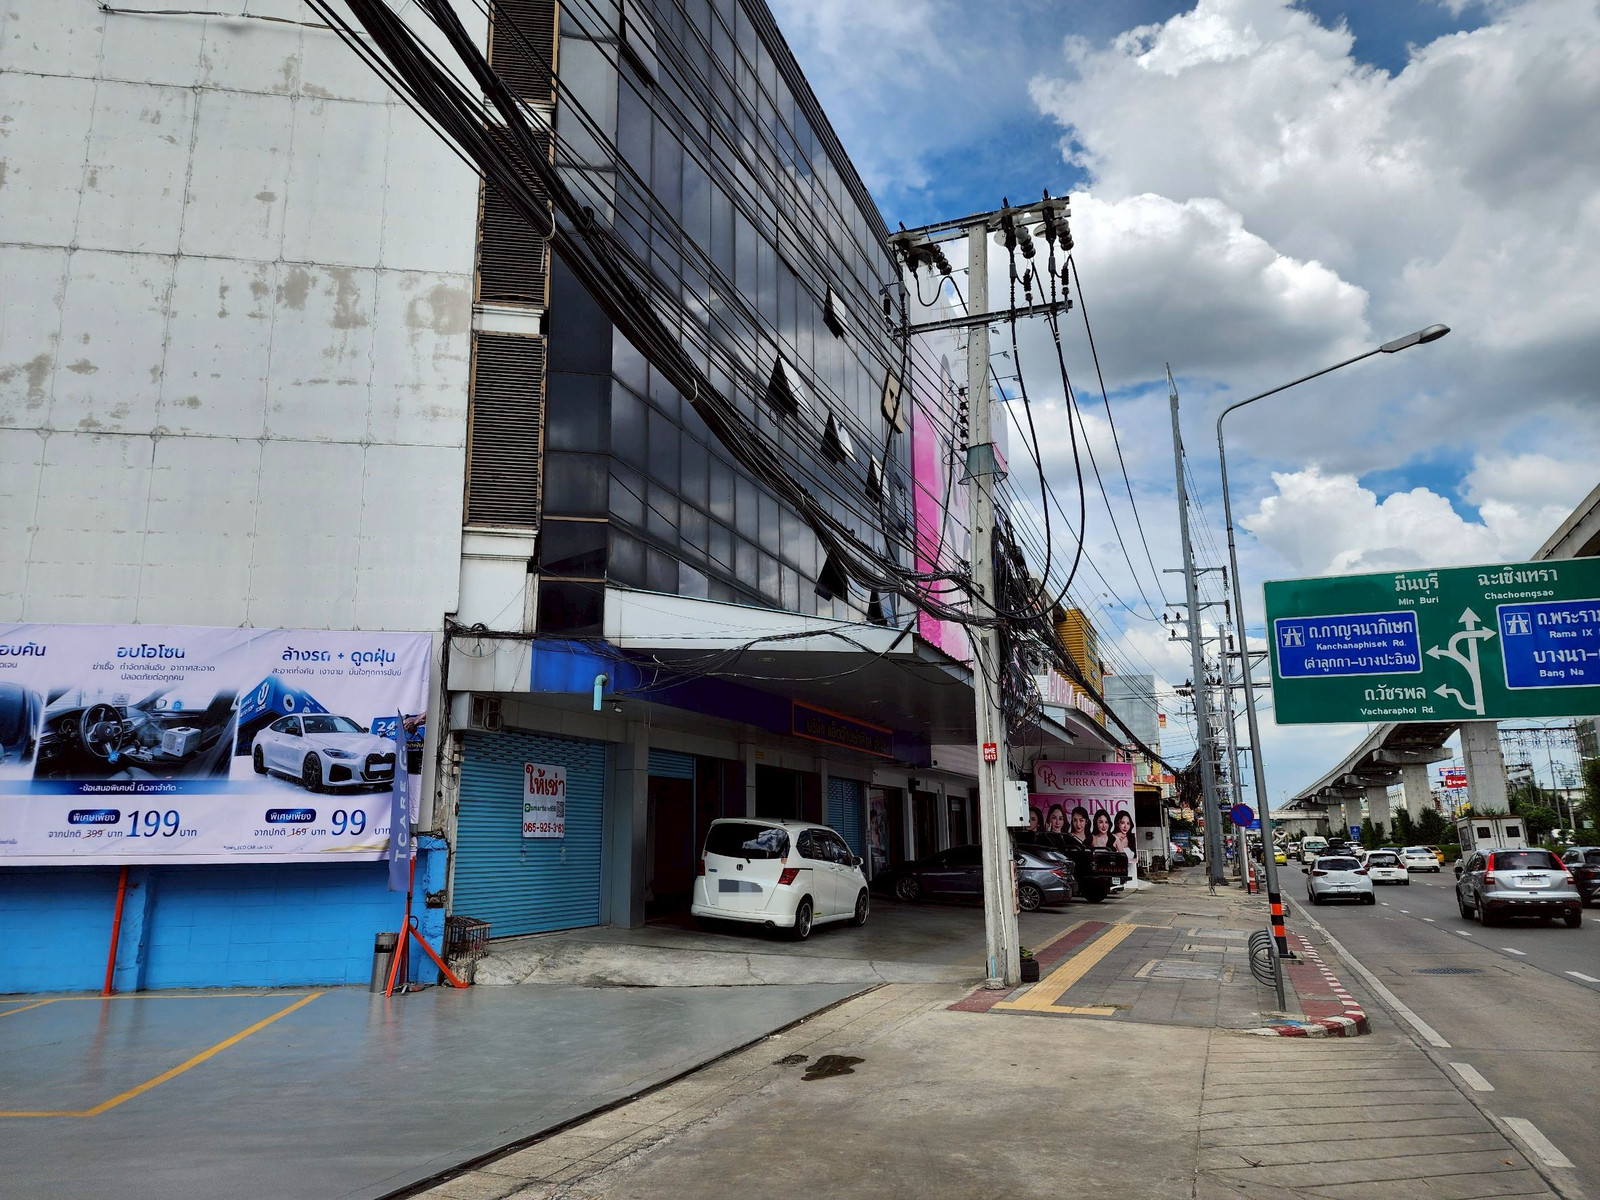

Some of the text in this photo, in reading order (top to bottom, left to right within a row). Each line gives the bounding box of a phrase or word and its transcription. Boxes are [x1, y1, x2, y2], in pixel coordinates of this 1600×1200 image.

[1478, 567, 1558, 585] ฉะเชิงเทรา
[1395, 573, 1439, 594] มีนบุรี
[1484, 590, 1554, 600] Chachoengsao
[1309, 618, 1413, 640] ถ.กาญจนาภิเษก
[1549, 630, 1577, 638] Rama
[117, 644, 185, 658] อบโอโซน
[1316, 640, 1387, 651] Kanchanaphisek
[282, 647, 331, 661] ล้างรถ
[351, 649, 396, 666] ดูดฝุ่น
[171, 664, 215, 672] อากาศสะอาด
[1540, 668, 1584, 678] Bang Na
[121, 673, 184, 682] ปลอดภัยต่อทุกคน
[1365, 684, 1426, 701] ถ.วัชรพล
[1360, 707, 1417, 716] Vacharaphol
[526, 764, 565, 796] ให้เช่า
[1063, 777, 1131, 788] PURRA CLINIC
[73, 812, 116, 822] พิเศษเพียง
[270, 812, 311, 821] พิเศษเพียง
[126, 810, 197, 837] 199 บาท
[331, 809, 367, 836] 99
[49, 828, 81, 838] จากปกติ
[107, 830, 123, 838] บาท
[254, 827, 286, 836] จากปกติ
